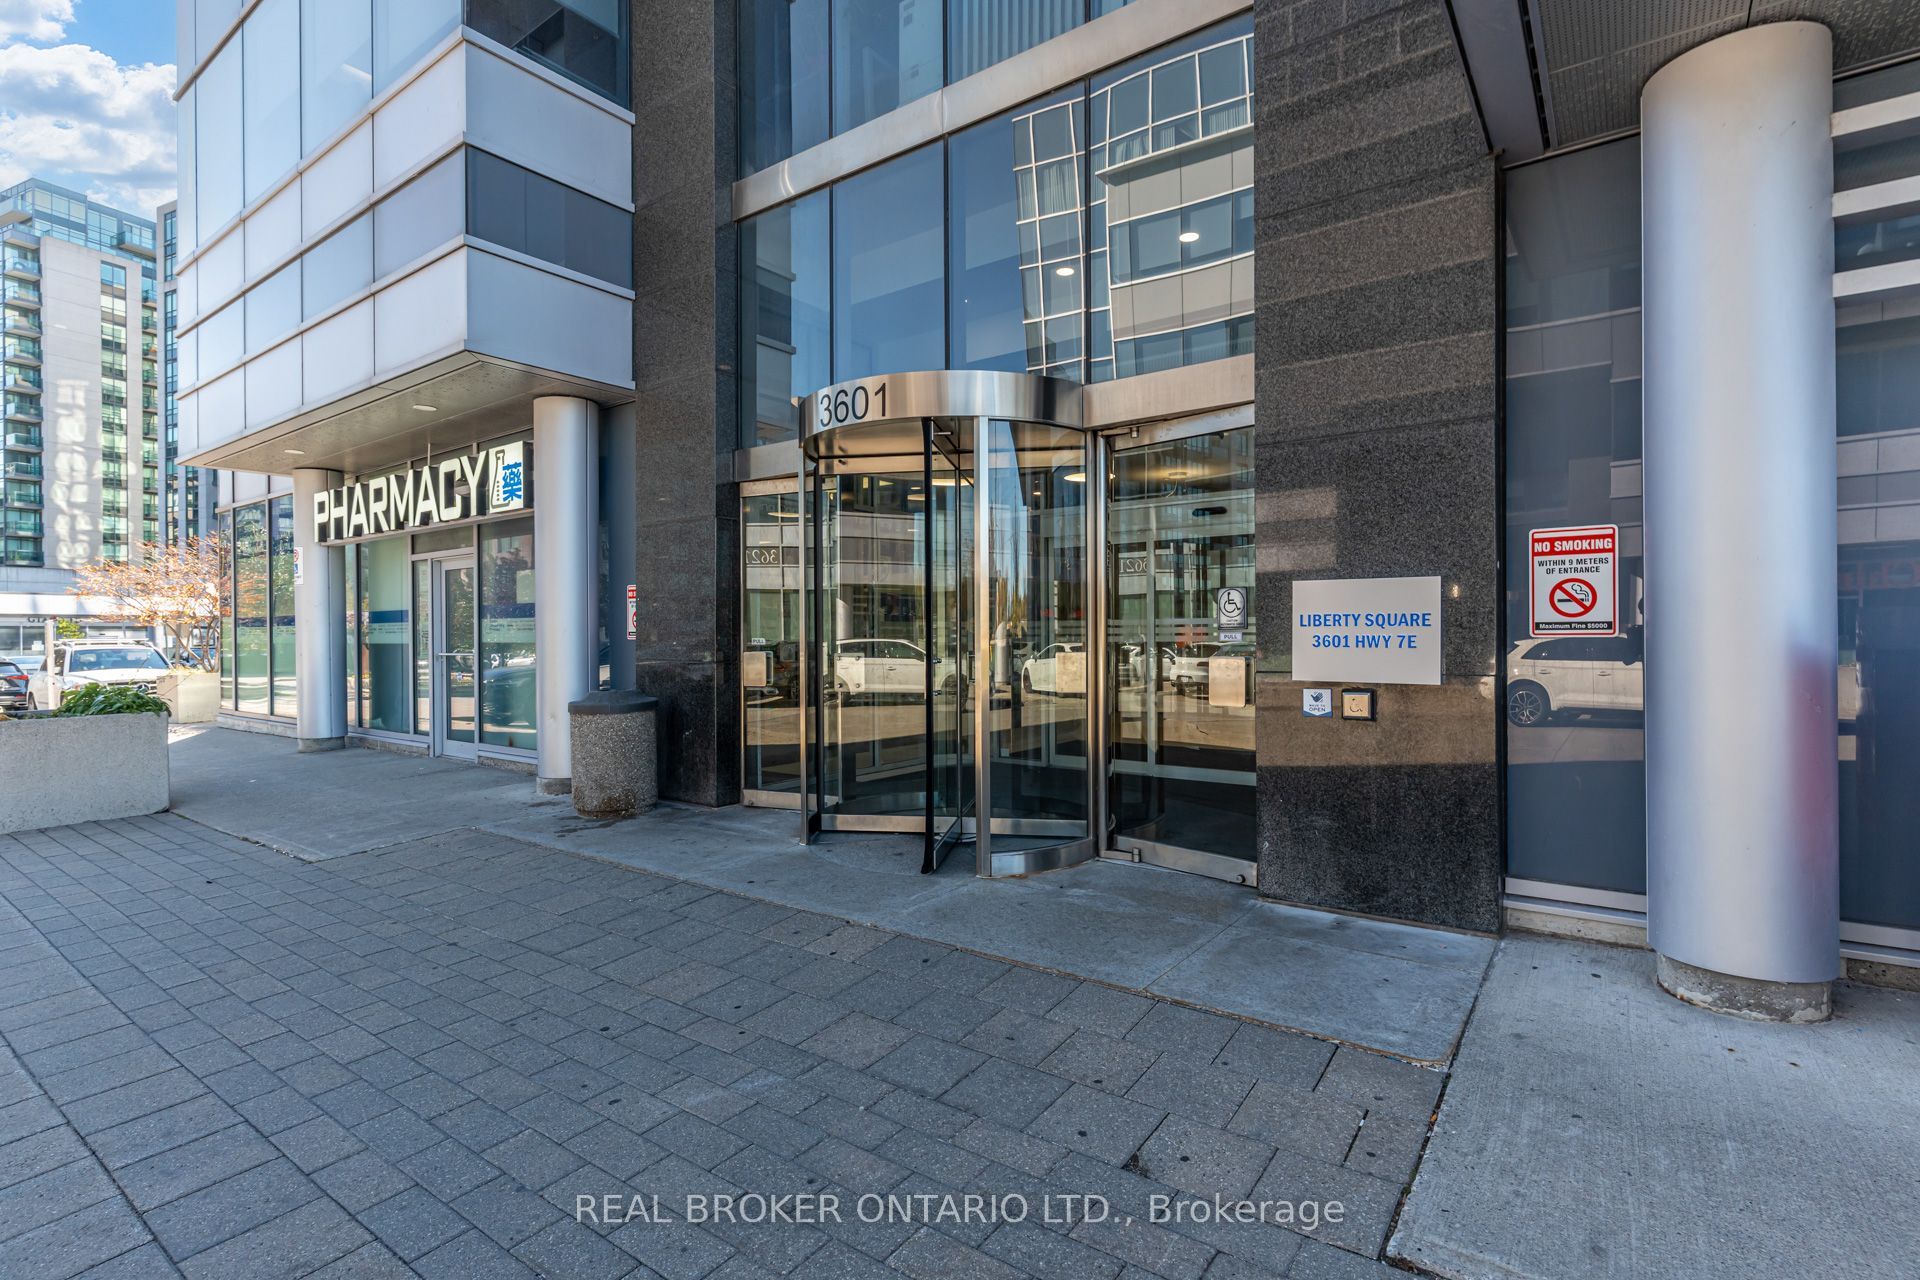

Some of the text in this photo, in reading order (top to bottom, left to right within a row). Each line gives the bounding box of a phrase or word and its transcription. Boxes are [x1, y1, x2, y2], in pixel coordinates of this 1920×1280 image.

[820, 382, 886, 427] 3601
[502, 461, 523, 502] 藥
[313, 450, 487, 543] PHARMACY
[1534, 537, 1613, 553] NO SMOKING
[1537, 557, 1609, 567] WITHIN 9 METERS
[1558, 566, 1600, 574] ENTRANCE
[1299, 612, 1432, 629] LIBERTY SQUARE
[1587, 622, 1608, 630] $5000
[1312, 634, 1417, 649] 3601 HWY 7E
